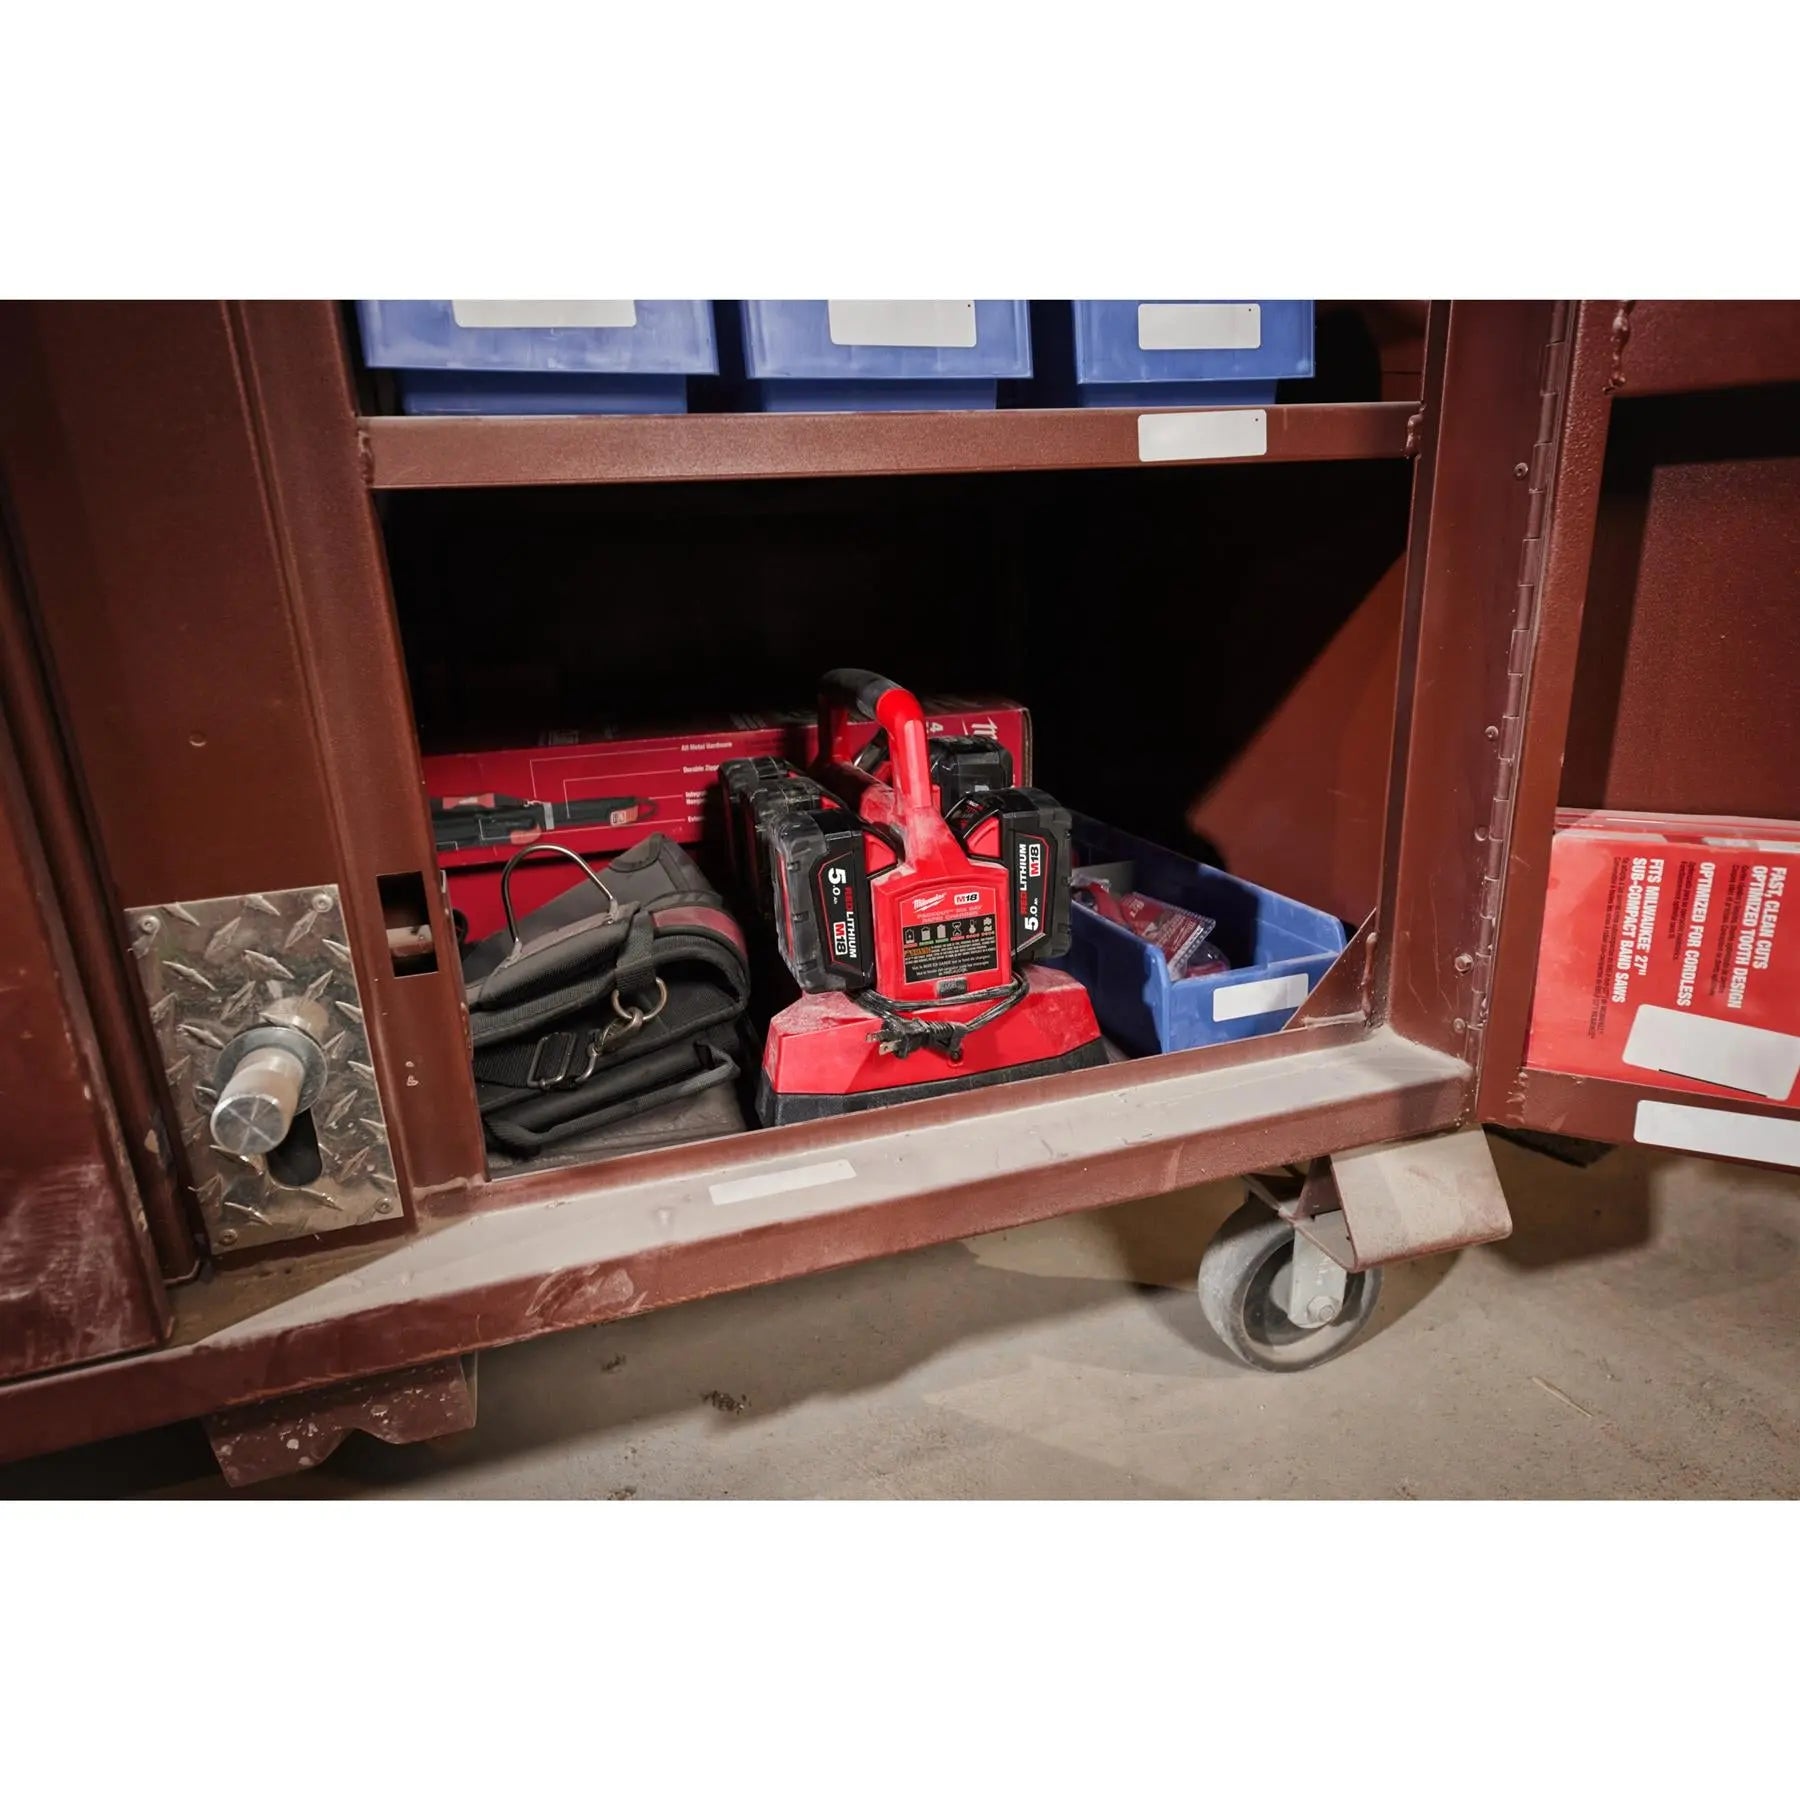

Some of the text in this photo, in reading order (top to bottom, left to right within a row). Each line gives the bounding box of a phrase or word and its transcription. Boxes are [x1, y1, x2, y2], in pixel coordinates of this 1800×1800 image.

[1029, 845, 1040, 876] M18
[1647, 858, 1664, 883] FITS
[828, 867, 847, 896] 5.0
[1691, 862, 1715, 923] OPTIMIZED
[1742, 865, 1768, 927] OPTIMIZED
[955, 893, 979, 904] M18
[1622, 857, 1647, 938] SUB-COMPACT
[1024, 905, 1039, 931] 5.0
[1752, 867, 1787, 969] FAST, CLEAN CUTS
[834, 922, 847, 954] M18
[1686, 925, 1704, 947] FOR
[1735, 929, 1756, 966] TOOTH
[1617, 940, 1634, 970] BAND
[1611, 972, 1629, 1003] SAWS
[1676, 950, 1700, 1007] CORDLESS
[1727, 967, 1748, 1009] DESIGN
